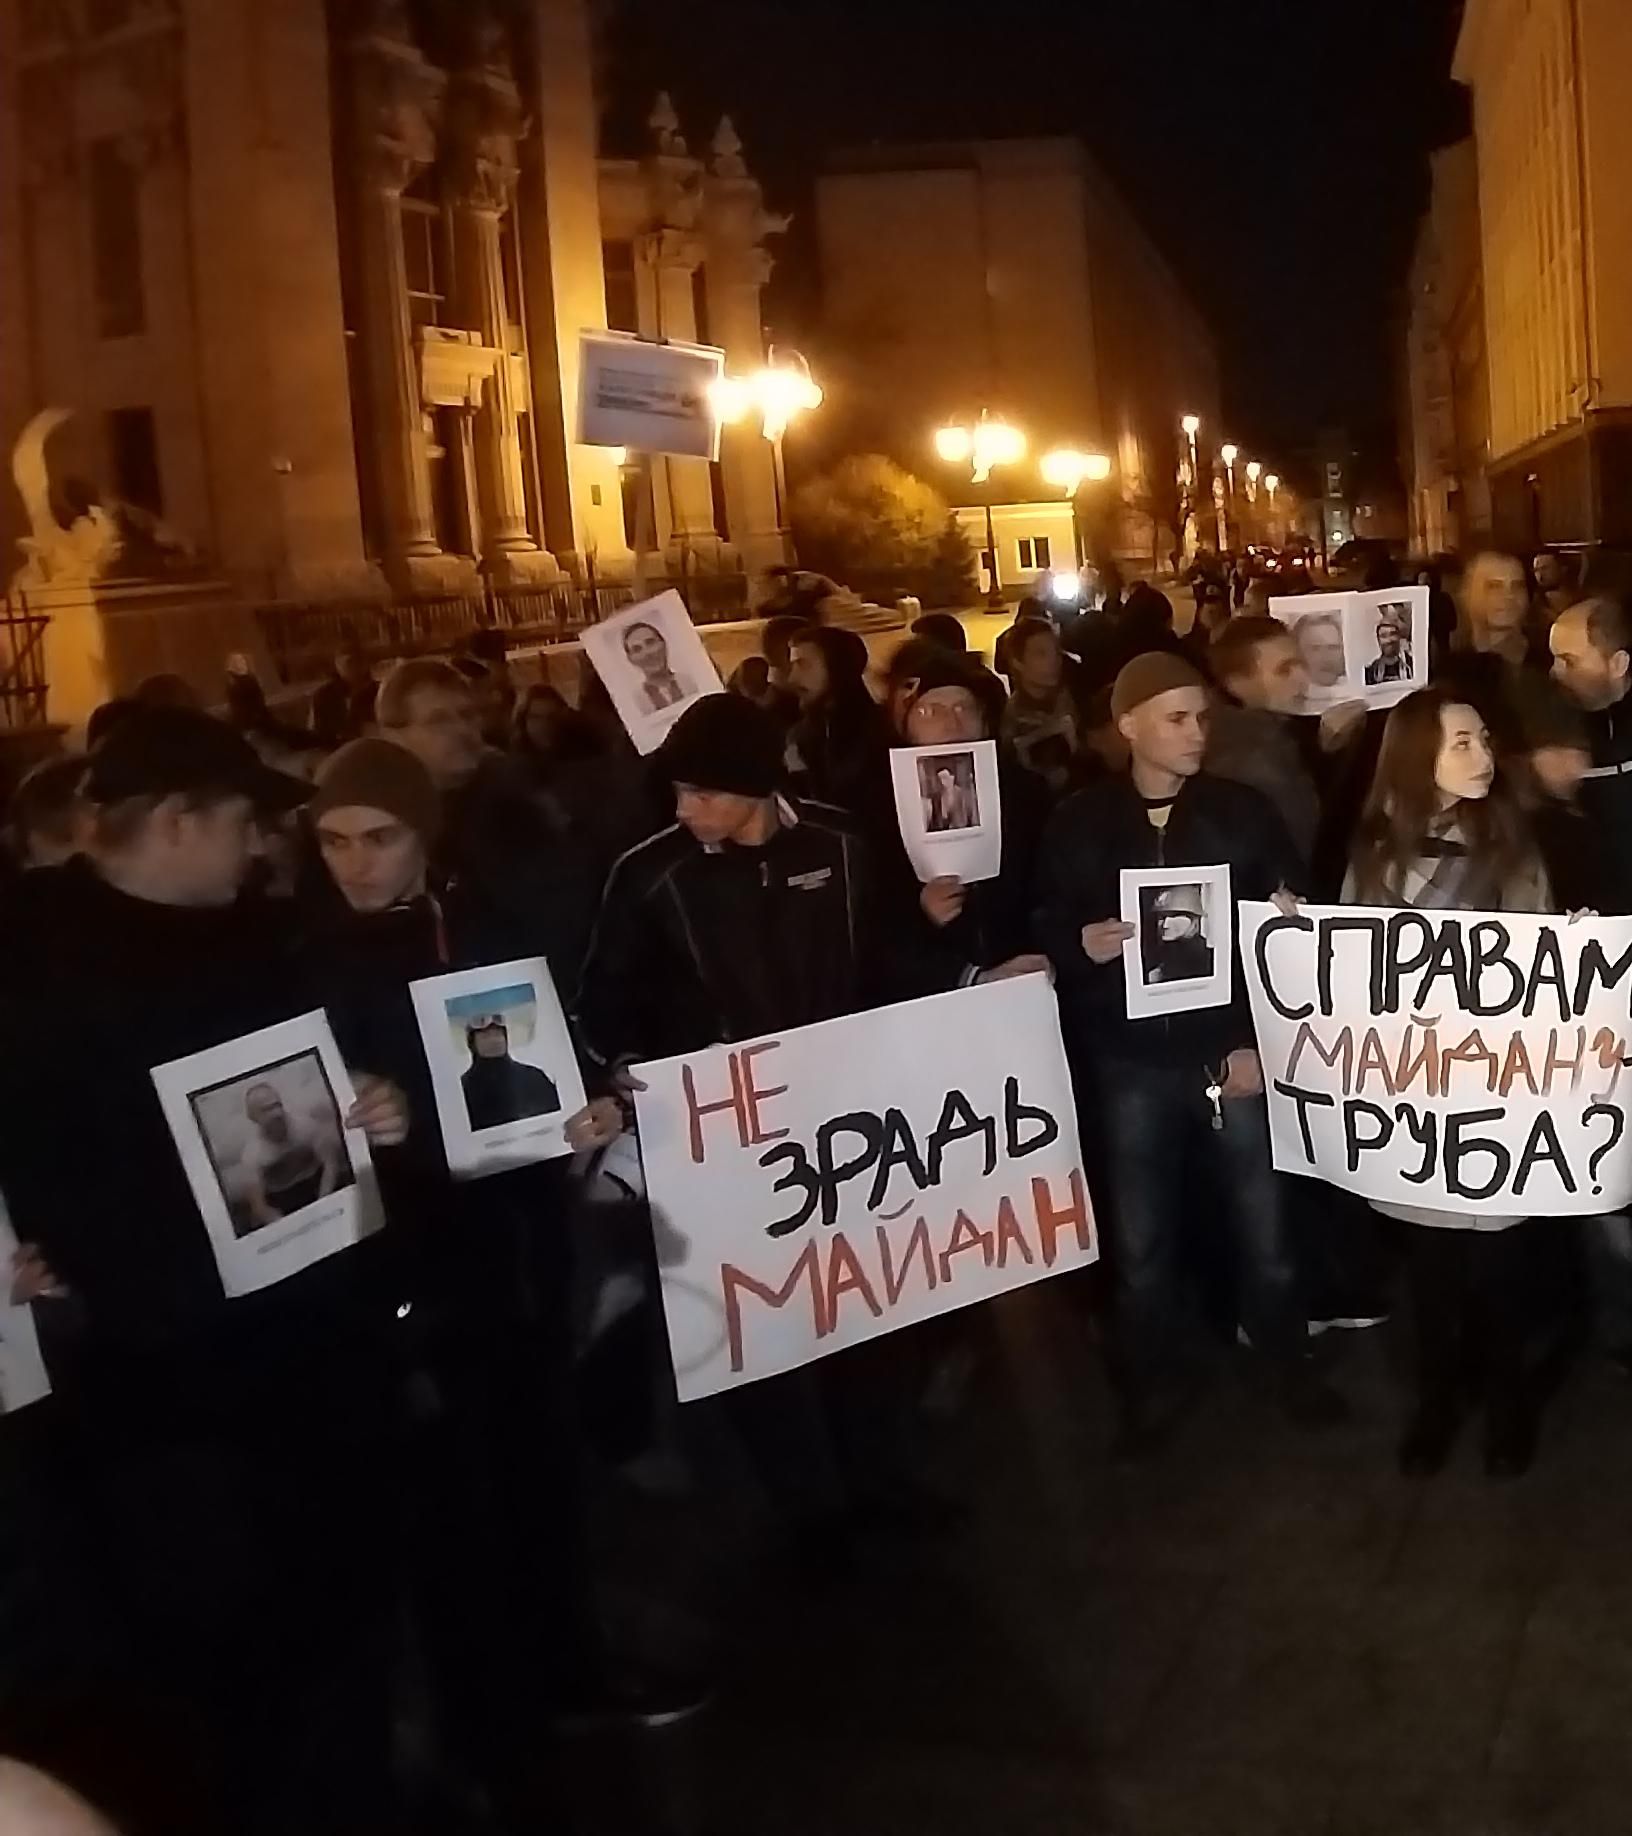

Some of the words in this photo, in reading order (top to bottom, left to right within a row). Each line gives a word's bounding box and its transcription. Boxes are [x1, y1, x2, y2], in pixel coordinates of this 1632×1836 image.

[683, 1041, 790, 1163] НЕ
[758, 1076, 1059, 1239] ЗРАДЬ
[1274, 1078, 1625, 1200] ТРУБА?
[721, 1167, 1093, 1372] МАЙДАН
